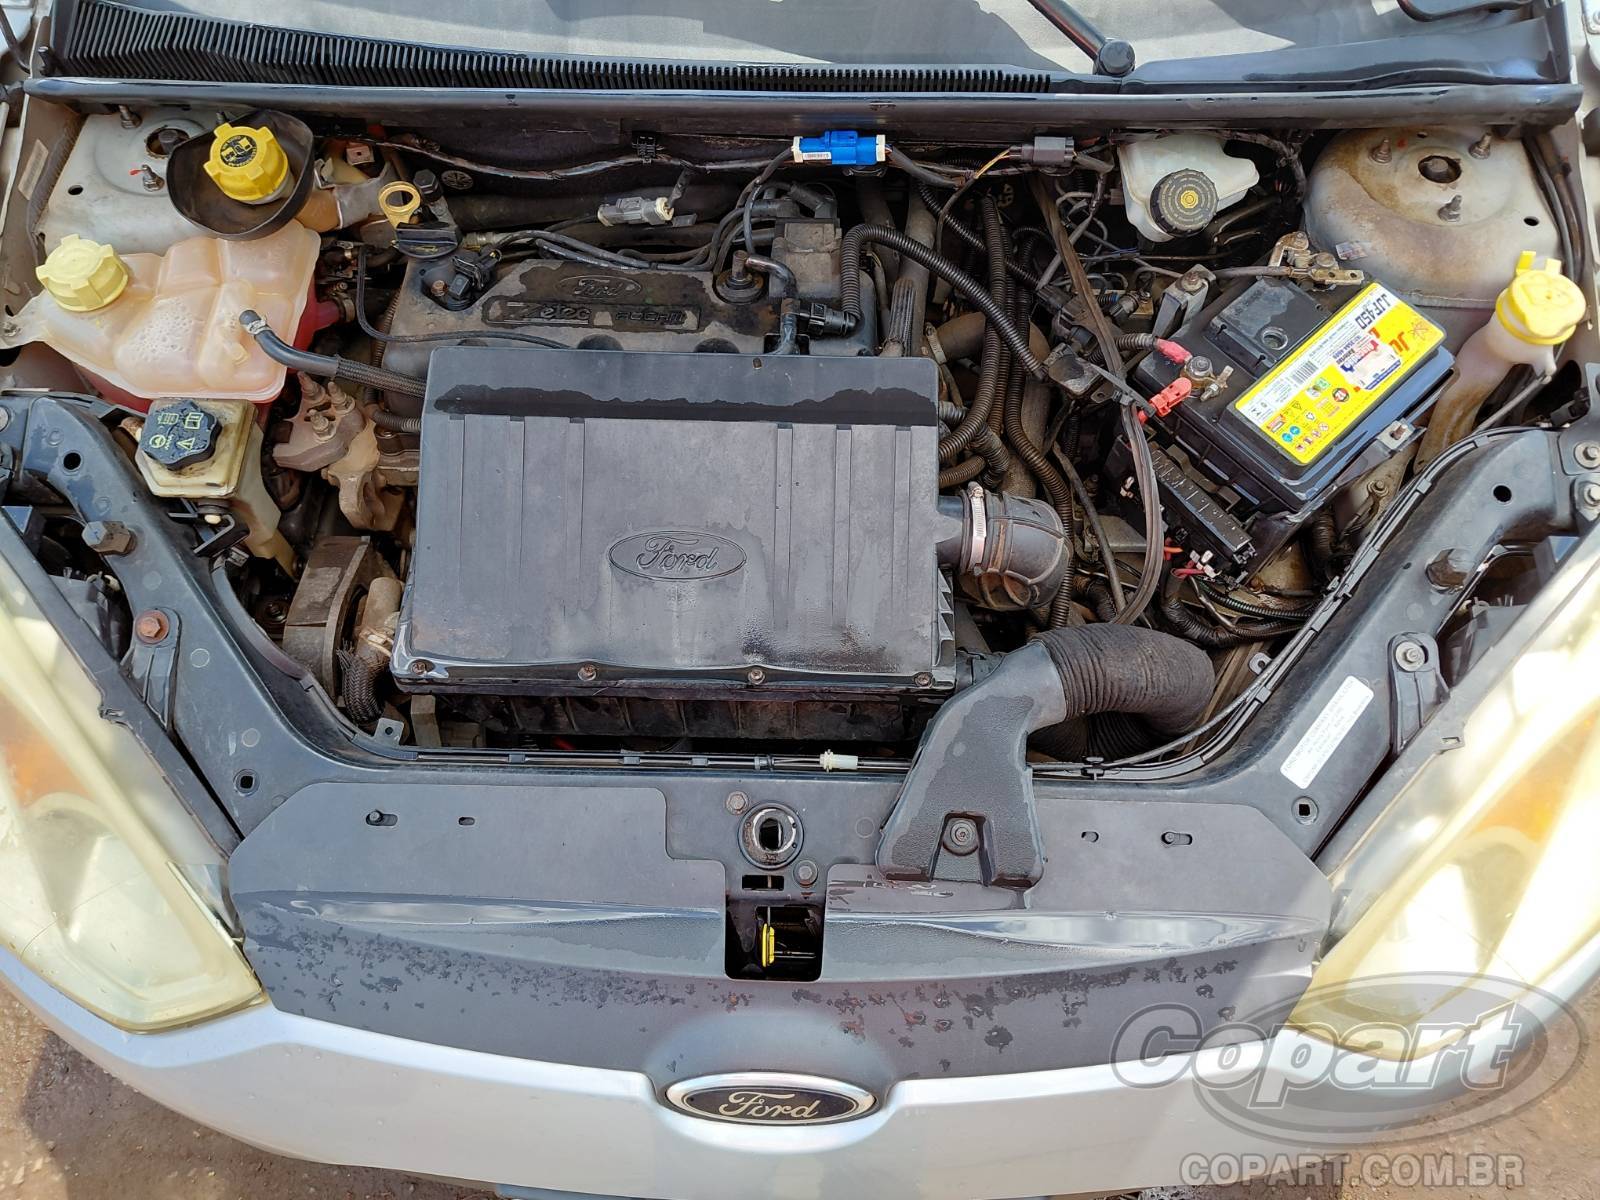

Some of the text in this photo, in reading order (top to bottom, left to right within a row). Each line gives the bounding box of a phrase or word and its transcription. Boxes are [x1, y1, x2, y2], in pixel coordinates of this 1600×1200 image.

[574, 278, 622, 297] Ford
[636, 535, 719, 570] Ford
[718, 1090, 821, 1119] Ford
